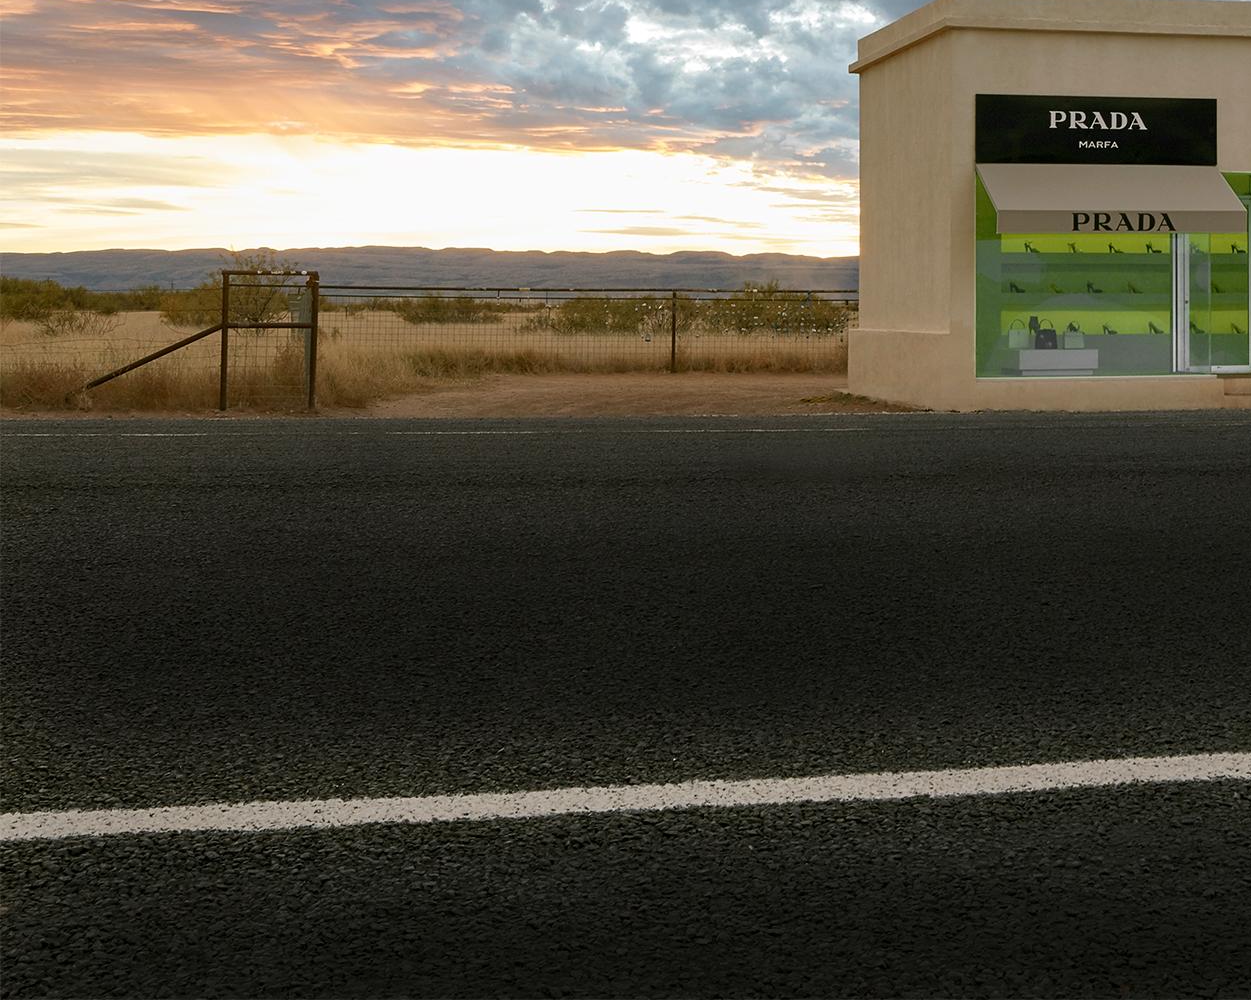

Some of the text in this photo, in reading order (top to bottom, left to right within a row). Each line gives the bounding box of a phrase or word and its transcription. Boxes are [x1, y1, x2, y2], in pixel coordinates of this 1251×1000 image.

[1048, 110, 1148, 130] PRADA
[1079, 140, 1119, 149] MARFA
[1072, 212, 1176, 231] PRADA
